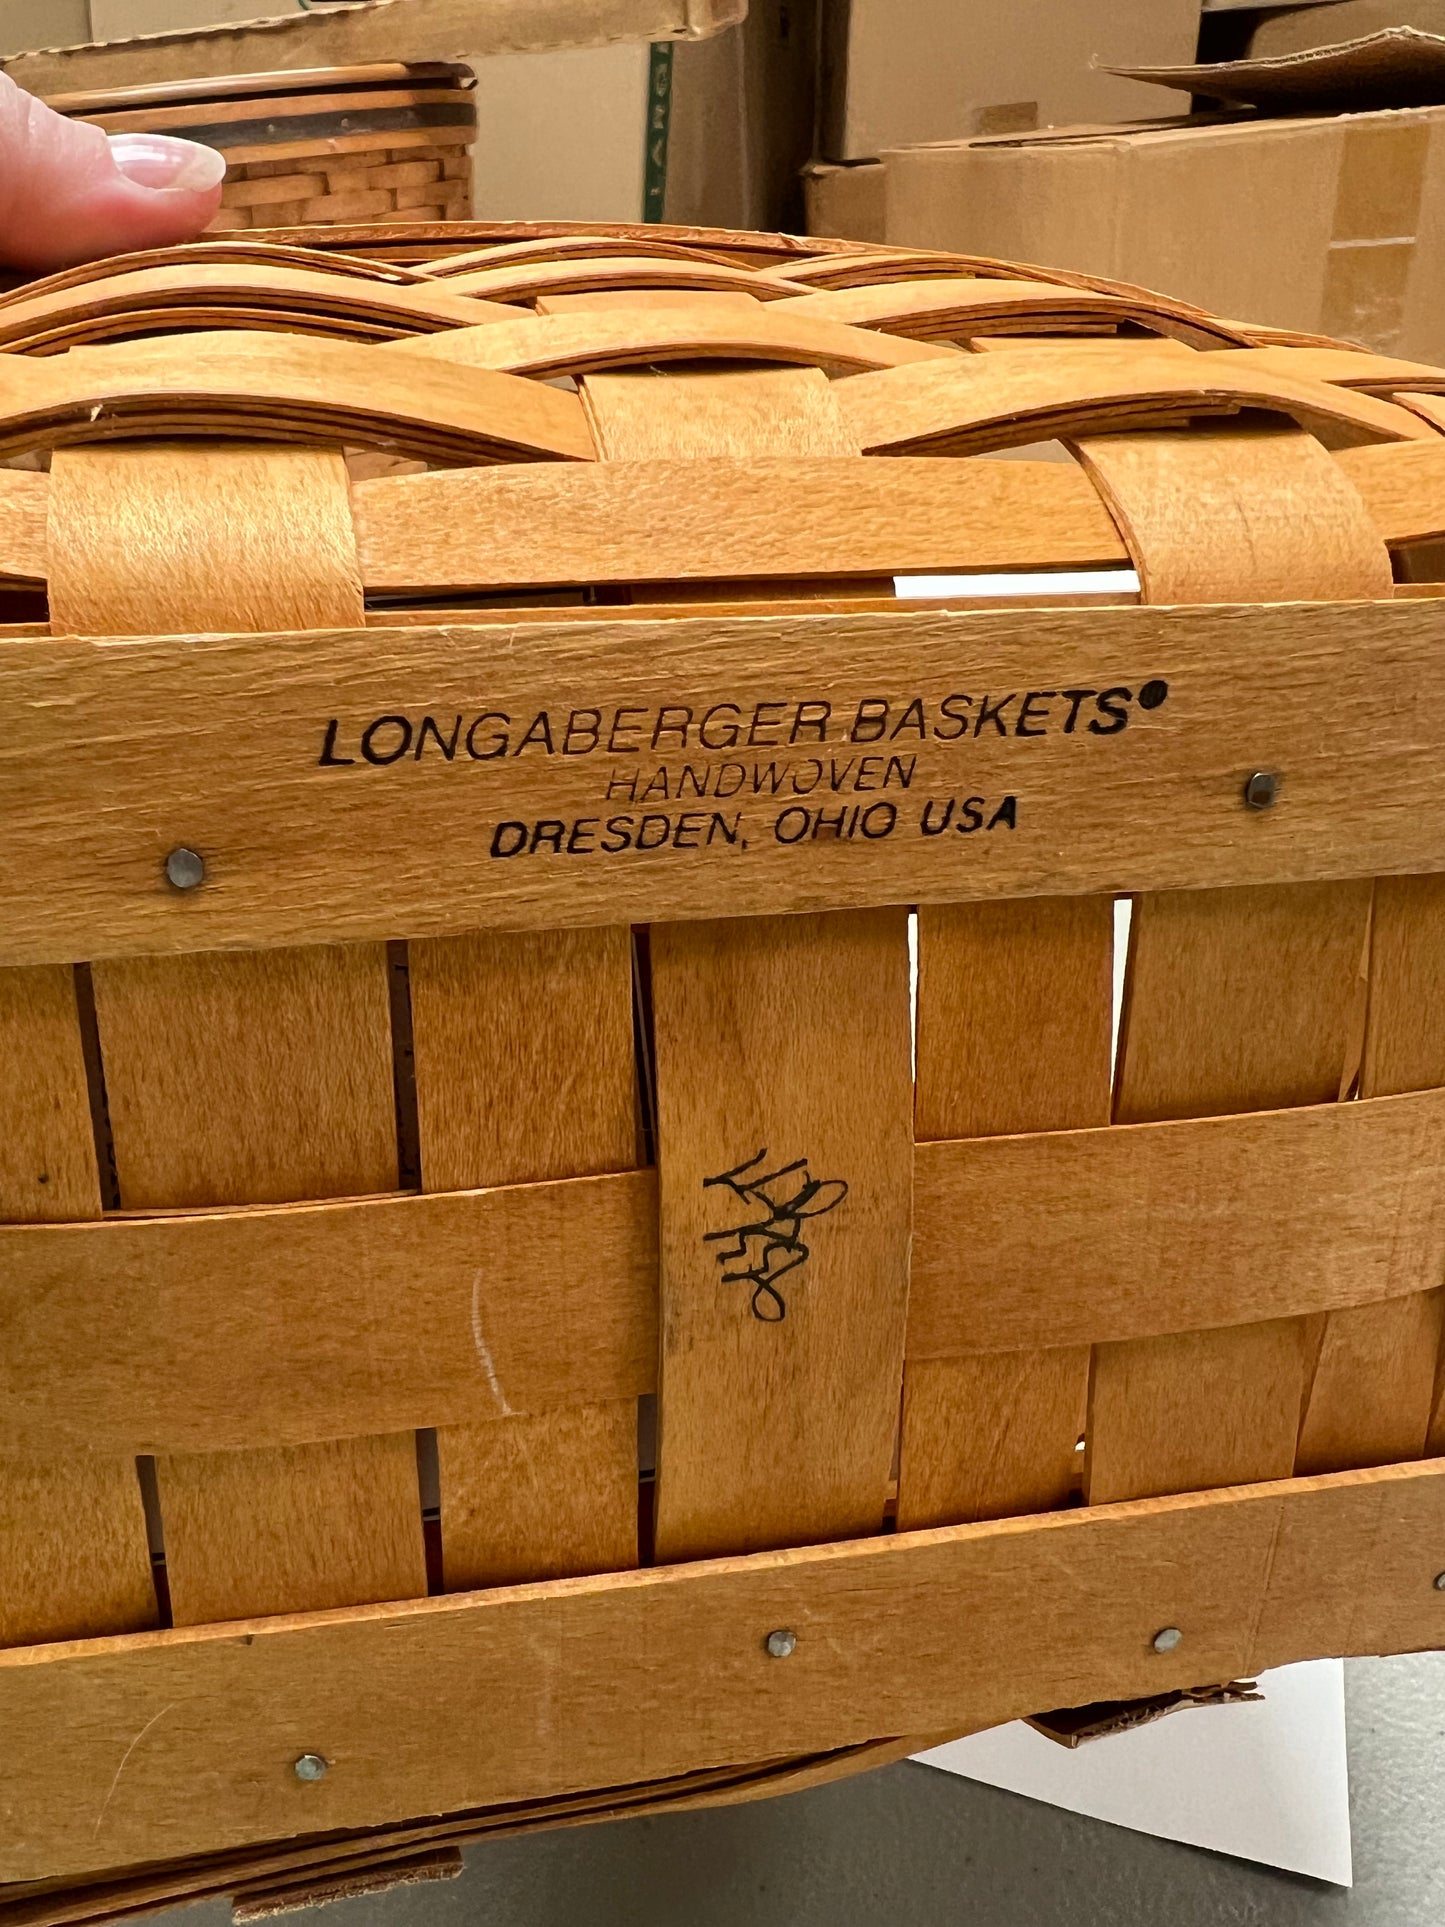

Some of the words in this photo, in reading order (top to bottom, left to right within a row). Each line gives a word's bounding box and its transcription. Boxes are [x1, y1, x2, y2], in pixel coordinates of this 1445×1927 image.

[318, 700, 832, 766] LONGABERGER
[605, 753, 918, 801] HANDWOVEN
[490, 811, 748, 858] DRESDEN,
[774, 801, 898, 844] OHIO
[920, 795, 1018, 837] USA
